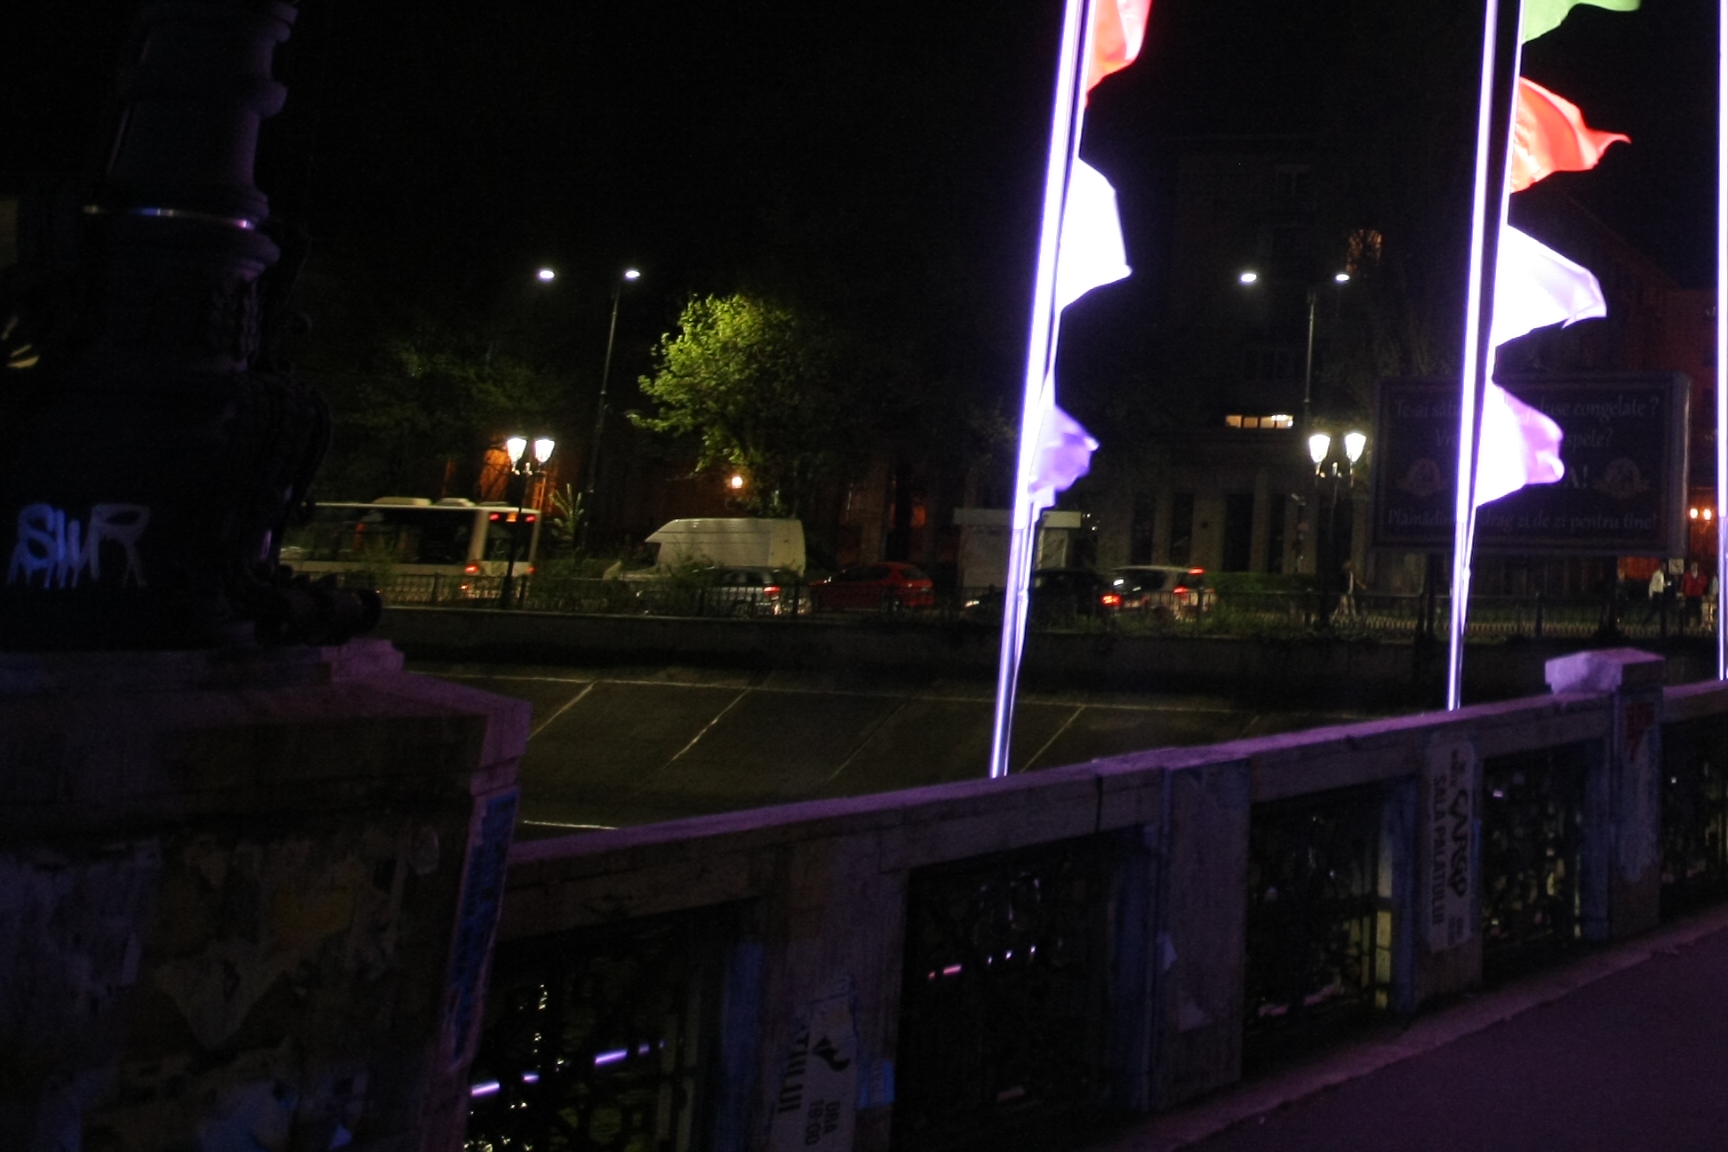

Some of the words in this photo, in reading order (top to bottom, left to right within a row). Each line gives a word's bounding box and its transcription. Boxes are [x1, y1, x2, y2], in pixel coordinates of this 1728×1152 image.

[1432, 774, 1447, 822] SALA
[1447, 788, 1469, 898] CARGO
[1431, 826, 1447, 926] PALATULUI
[804, 1099, 824, 1146] 19:00
[823, 1101, 840, 1135] ORA
